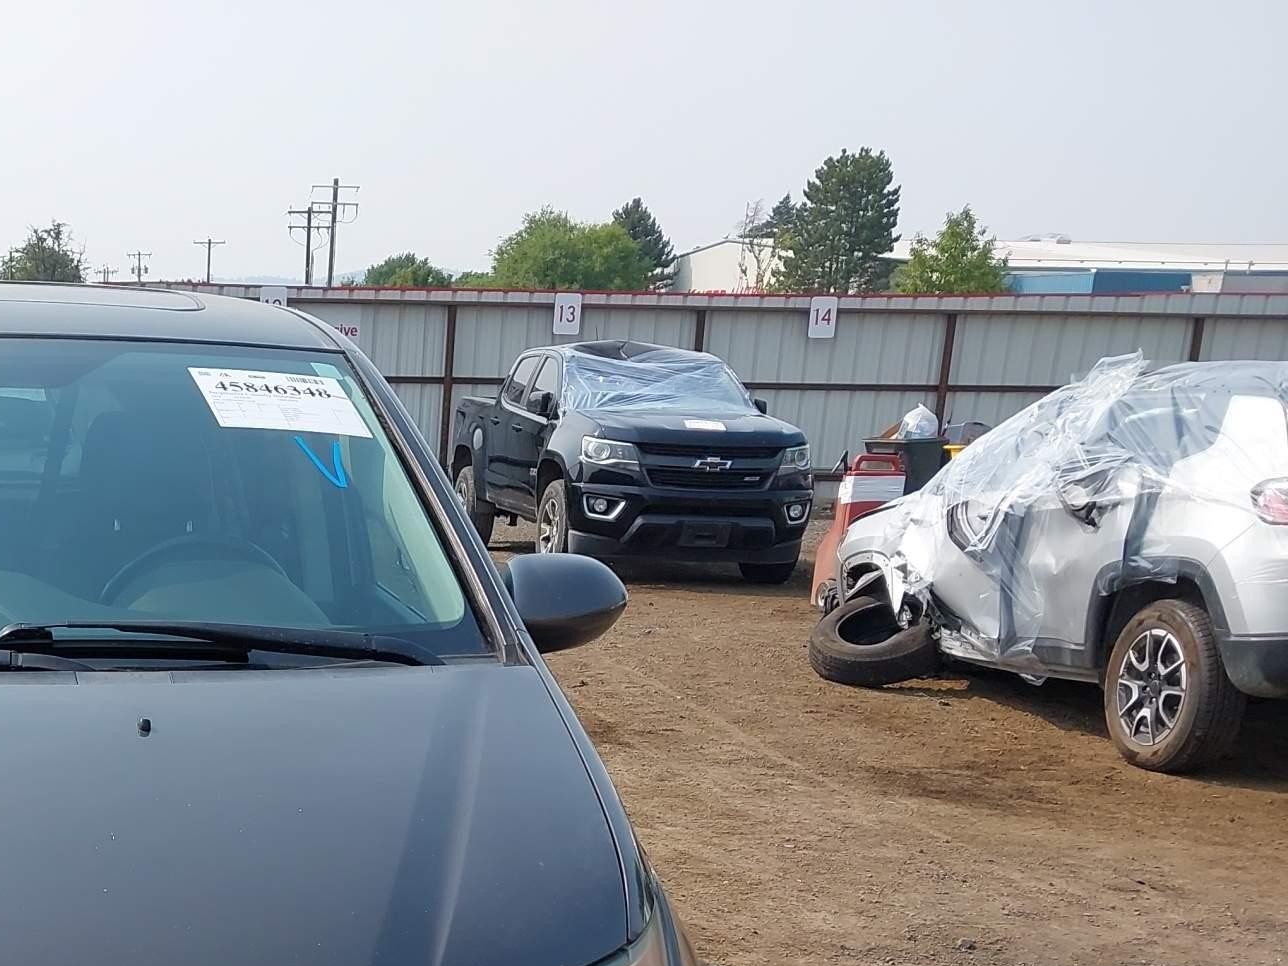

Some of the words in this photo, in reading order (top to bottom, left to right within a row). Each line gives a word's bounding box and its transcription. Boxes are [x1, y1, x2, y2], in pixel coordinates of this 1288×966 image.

[559, 304, 576, 323] 13
[813, 308, 832, 326] 14
[215, 381, 332, 399] 45846348
